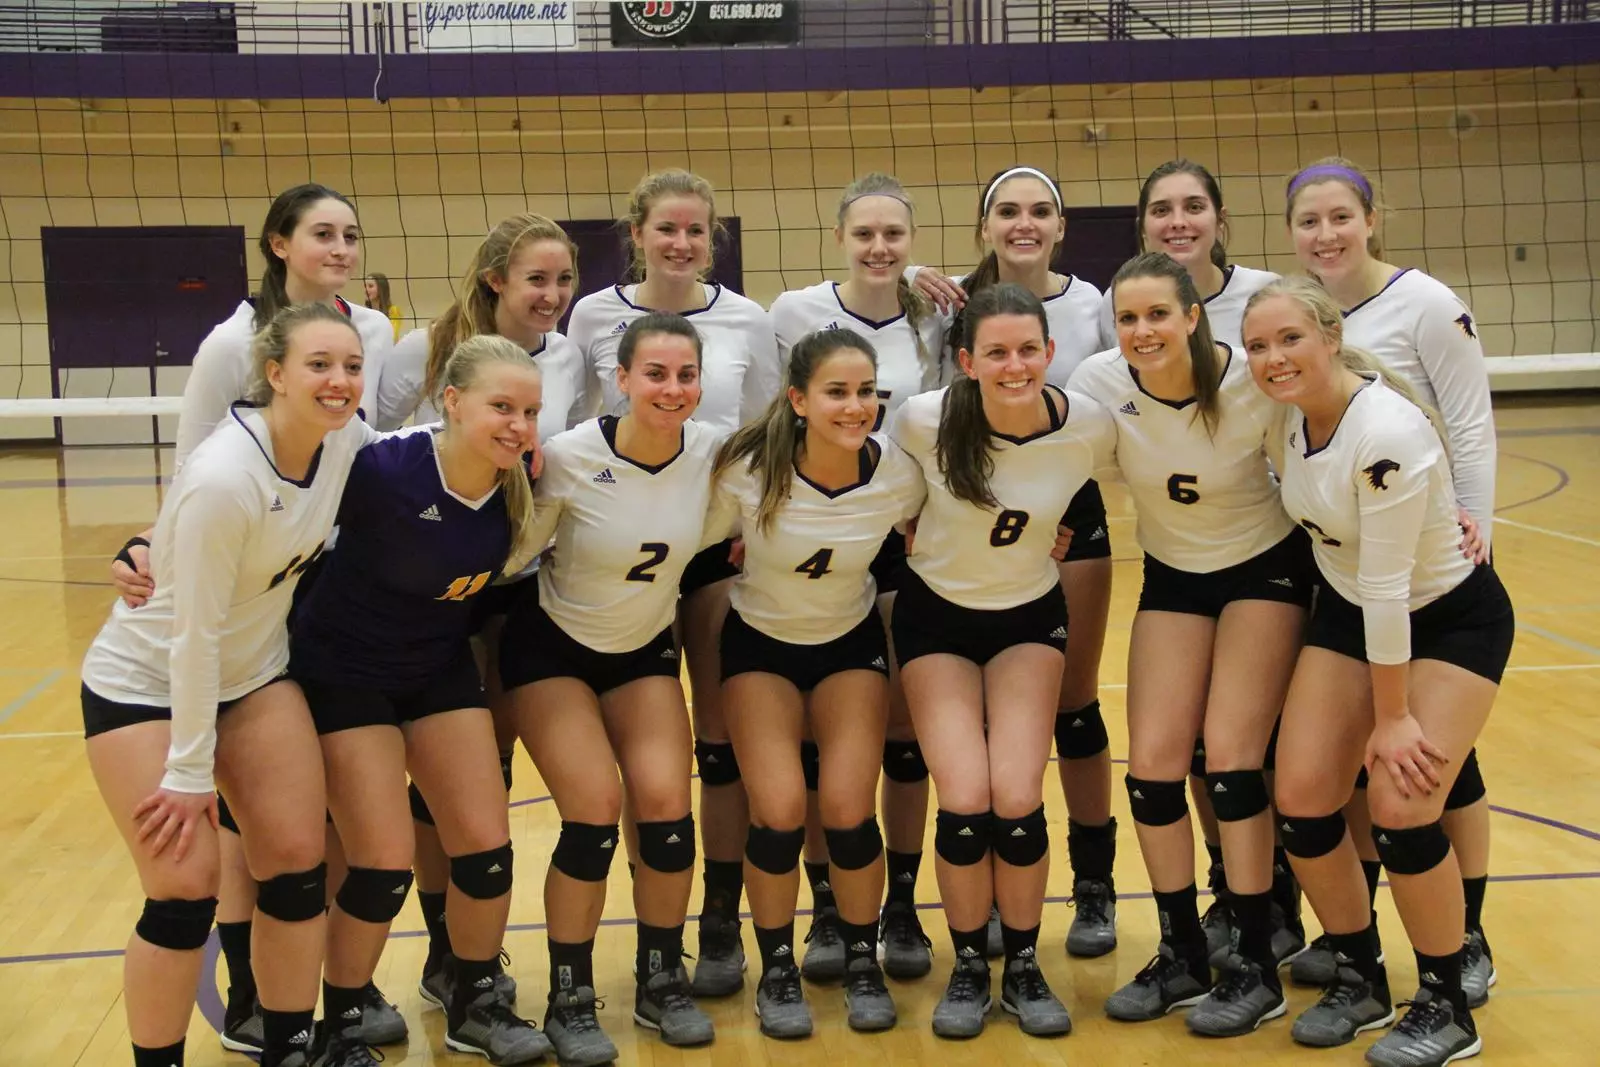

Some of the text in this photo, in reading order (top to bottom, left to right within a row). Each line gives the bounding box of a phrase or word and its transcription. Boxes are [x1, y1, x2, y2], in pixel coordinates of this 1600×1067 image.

[425, 1, 568, 33] tjsportsonline.net
[1167, 473, 1201, 505] 6
[989, 509, 1030, 548] 8
[624, 542, 670, 583] 2
[793, 547, 834, 580] 4
[433, 570, 492, 601] 11
